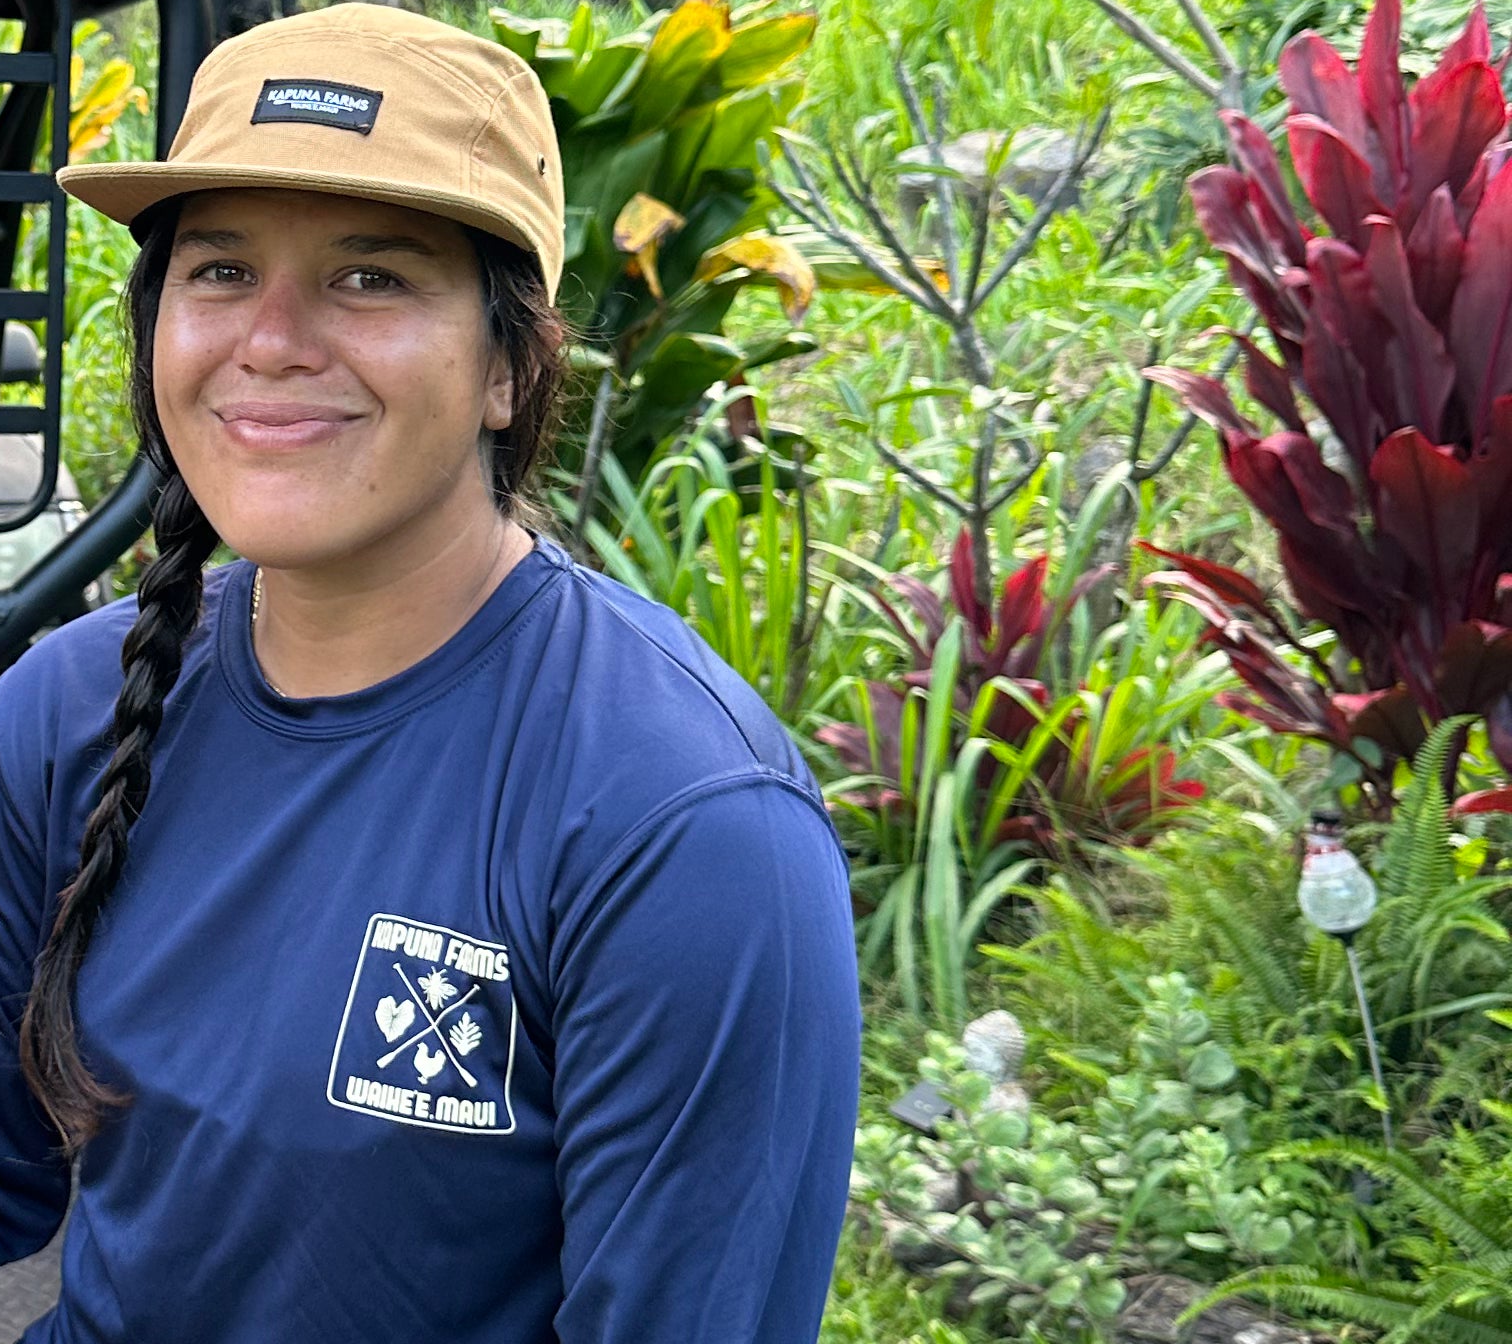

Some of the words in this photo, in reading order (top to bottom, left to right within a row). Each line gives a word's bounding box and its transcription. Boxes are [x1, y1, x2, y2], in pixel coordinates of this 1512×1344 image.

[267, 89, 321, 102] KAPUNA
[324, 91, 370, 111] FARMS
[435, 1096, 496, 1127] MAUI
